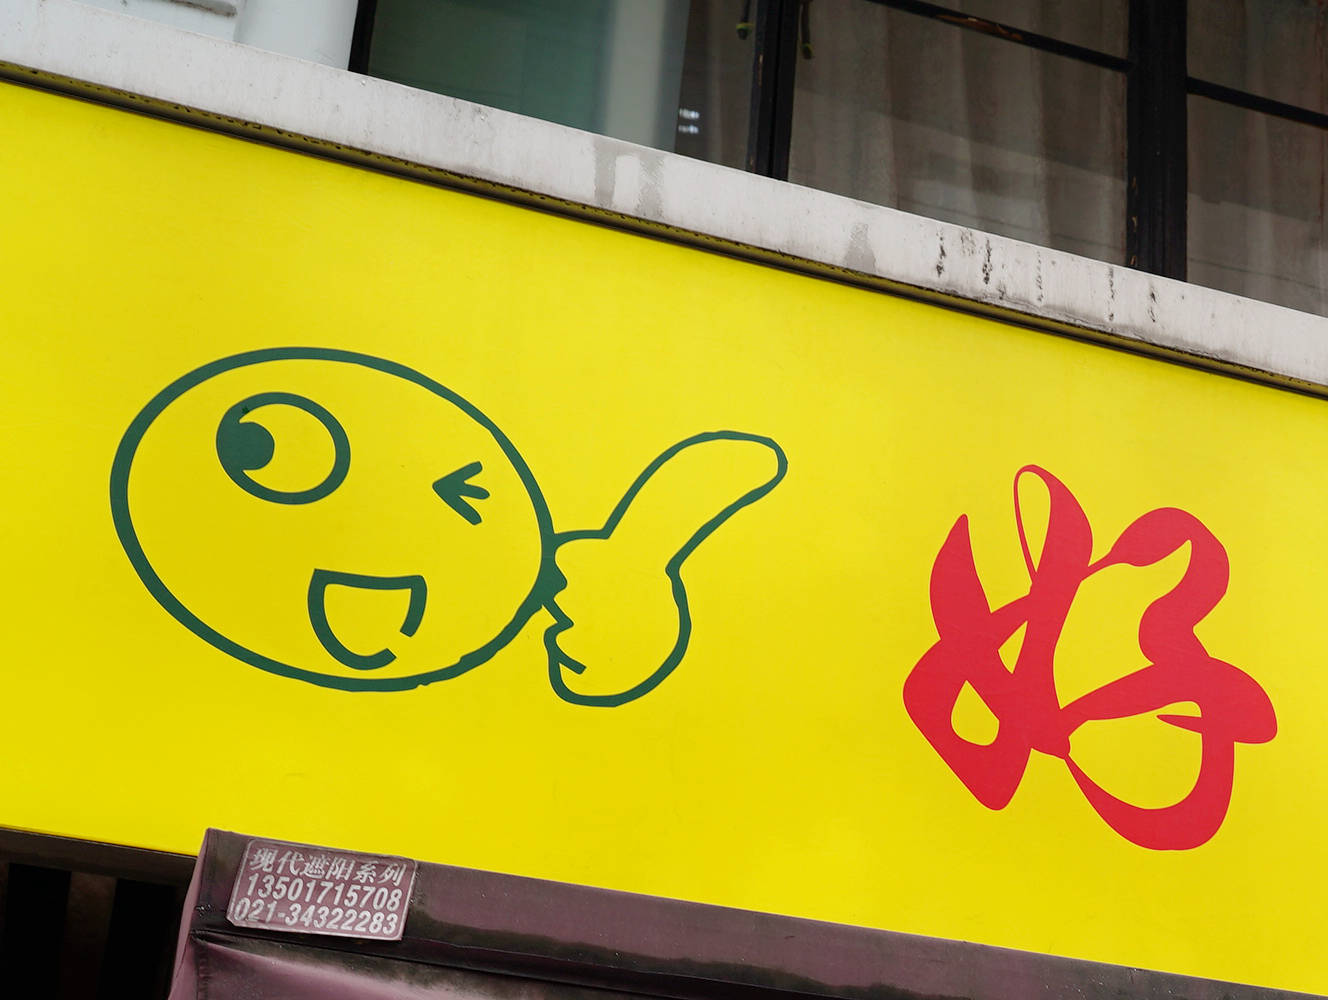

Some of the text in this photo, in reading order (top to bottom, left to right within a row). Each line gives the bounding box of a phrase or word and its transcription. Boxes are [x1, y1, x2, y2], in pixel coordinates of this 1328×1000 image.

[250, 847, 407, 887] 现代遮阳系列
[247, 872, 403, 912] 13501715708
[233, 897, 399, 936] 021-34322283
